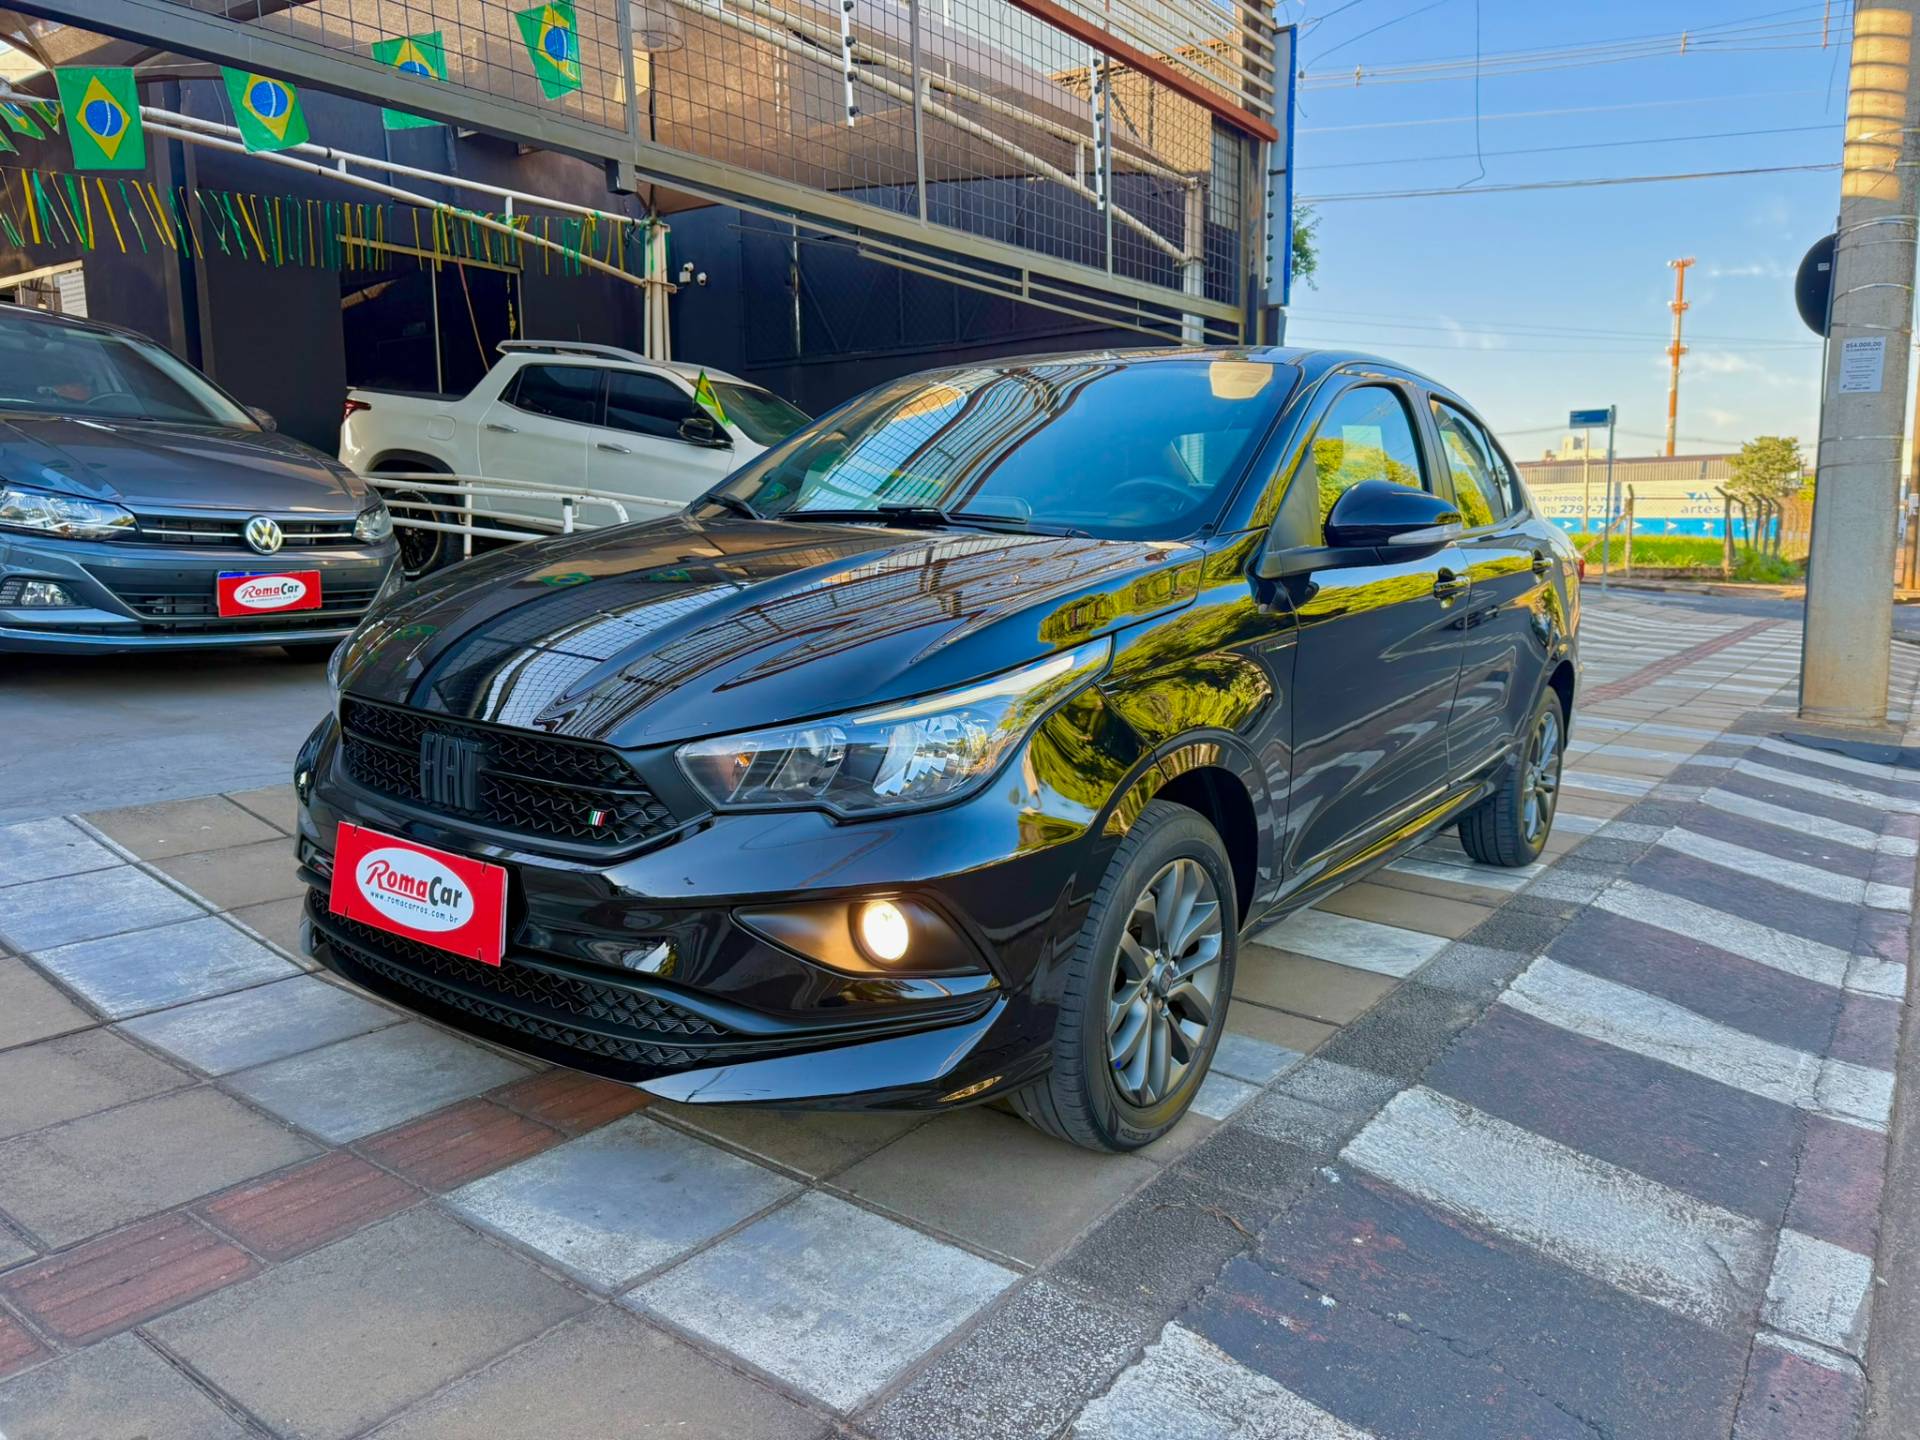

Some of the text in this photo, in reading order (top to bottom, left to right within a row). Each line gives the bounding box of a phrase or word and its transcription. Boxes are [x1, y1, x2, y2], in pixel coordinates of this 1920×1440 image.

[241, 583, 300, 599] RomaCar
[420, 732, 483, 811] FIAT
[365, 859, 463, 908] RomaCar
[370, 891, 459, 924] www.romacarros.com.br
